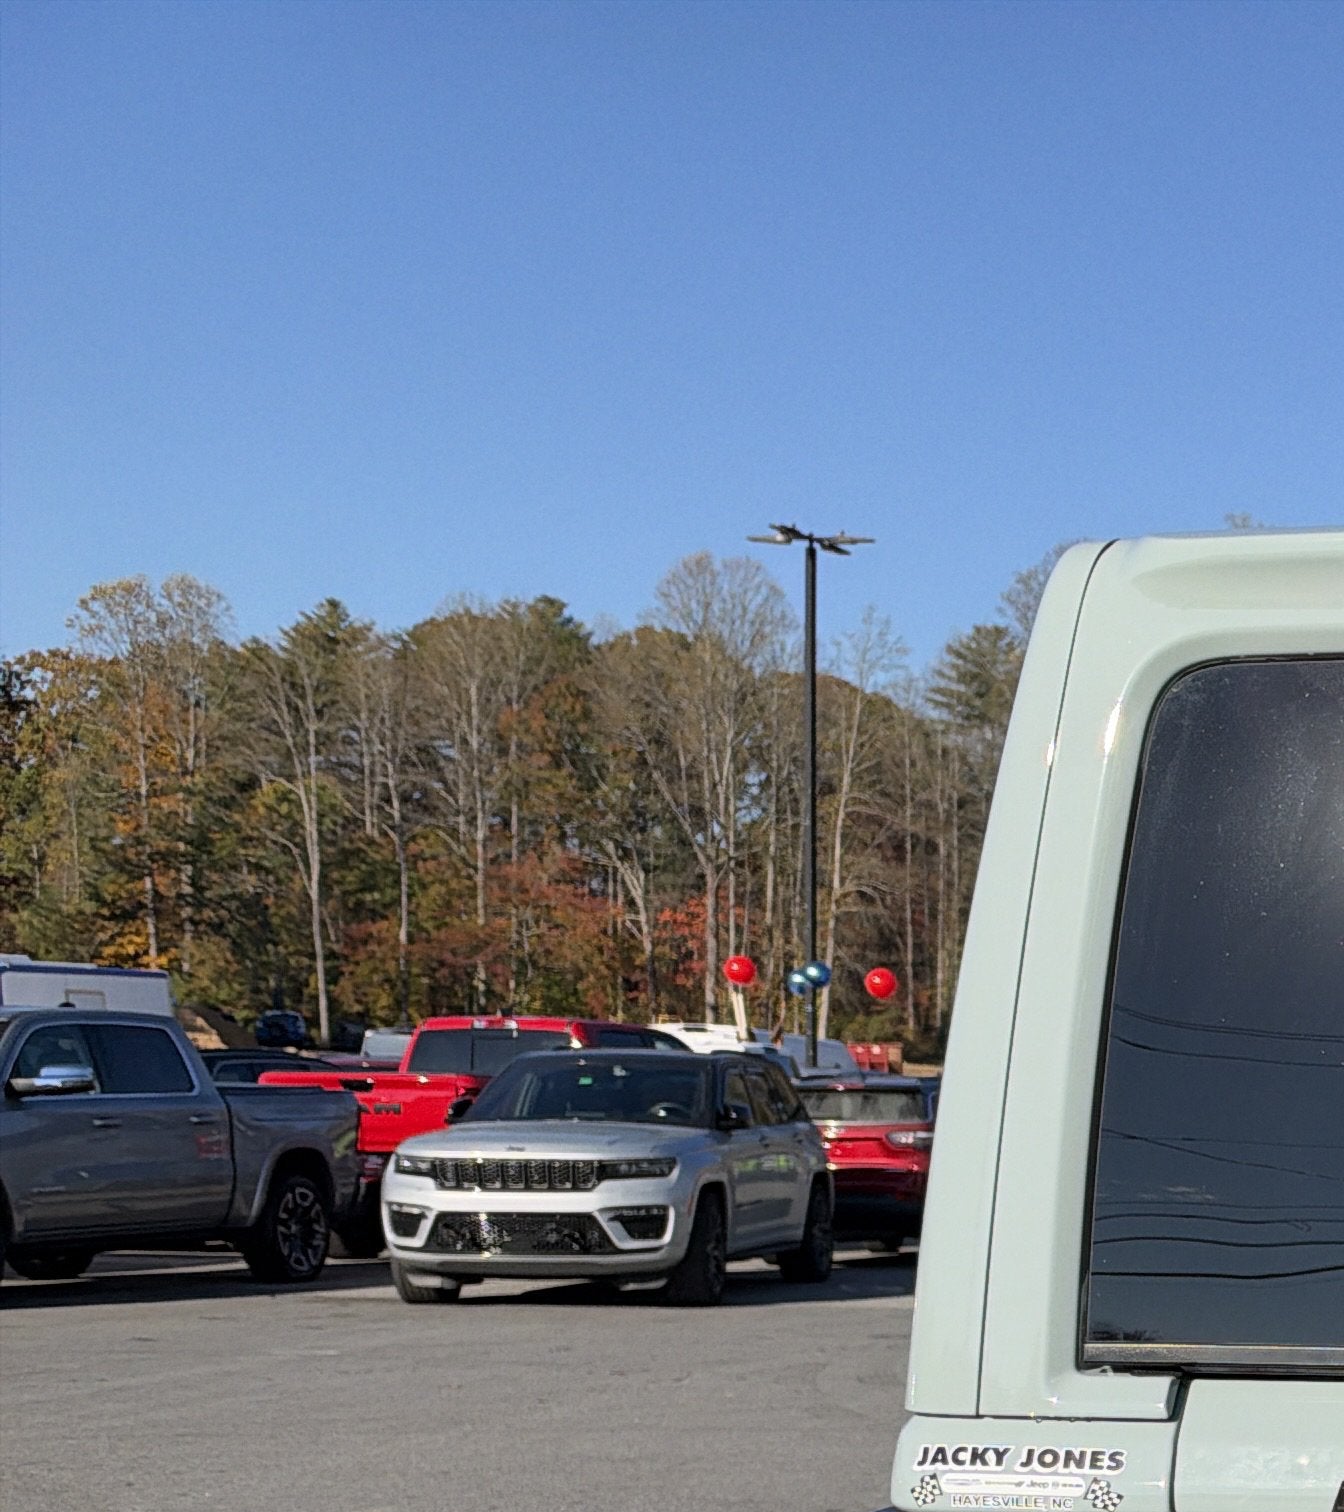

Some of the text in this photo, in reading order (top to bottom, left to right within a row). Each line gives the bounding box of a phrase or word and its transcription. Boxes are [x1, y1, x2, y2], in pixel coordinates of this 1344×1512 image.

[916, 1446, 1125, 1471] JACKY JONES
[953, 1495, 1073, 1511] HAYESVILLE, NC
